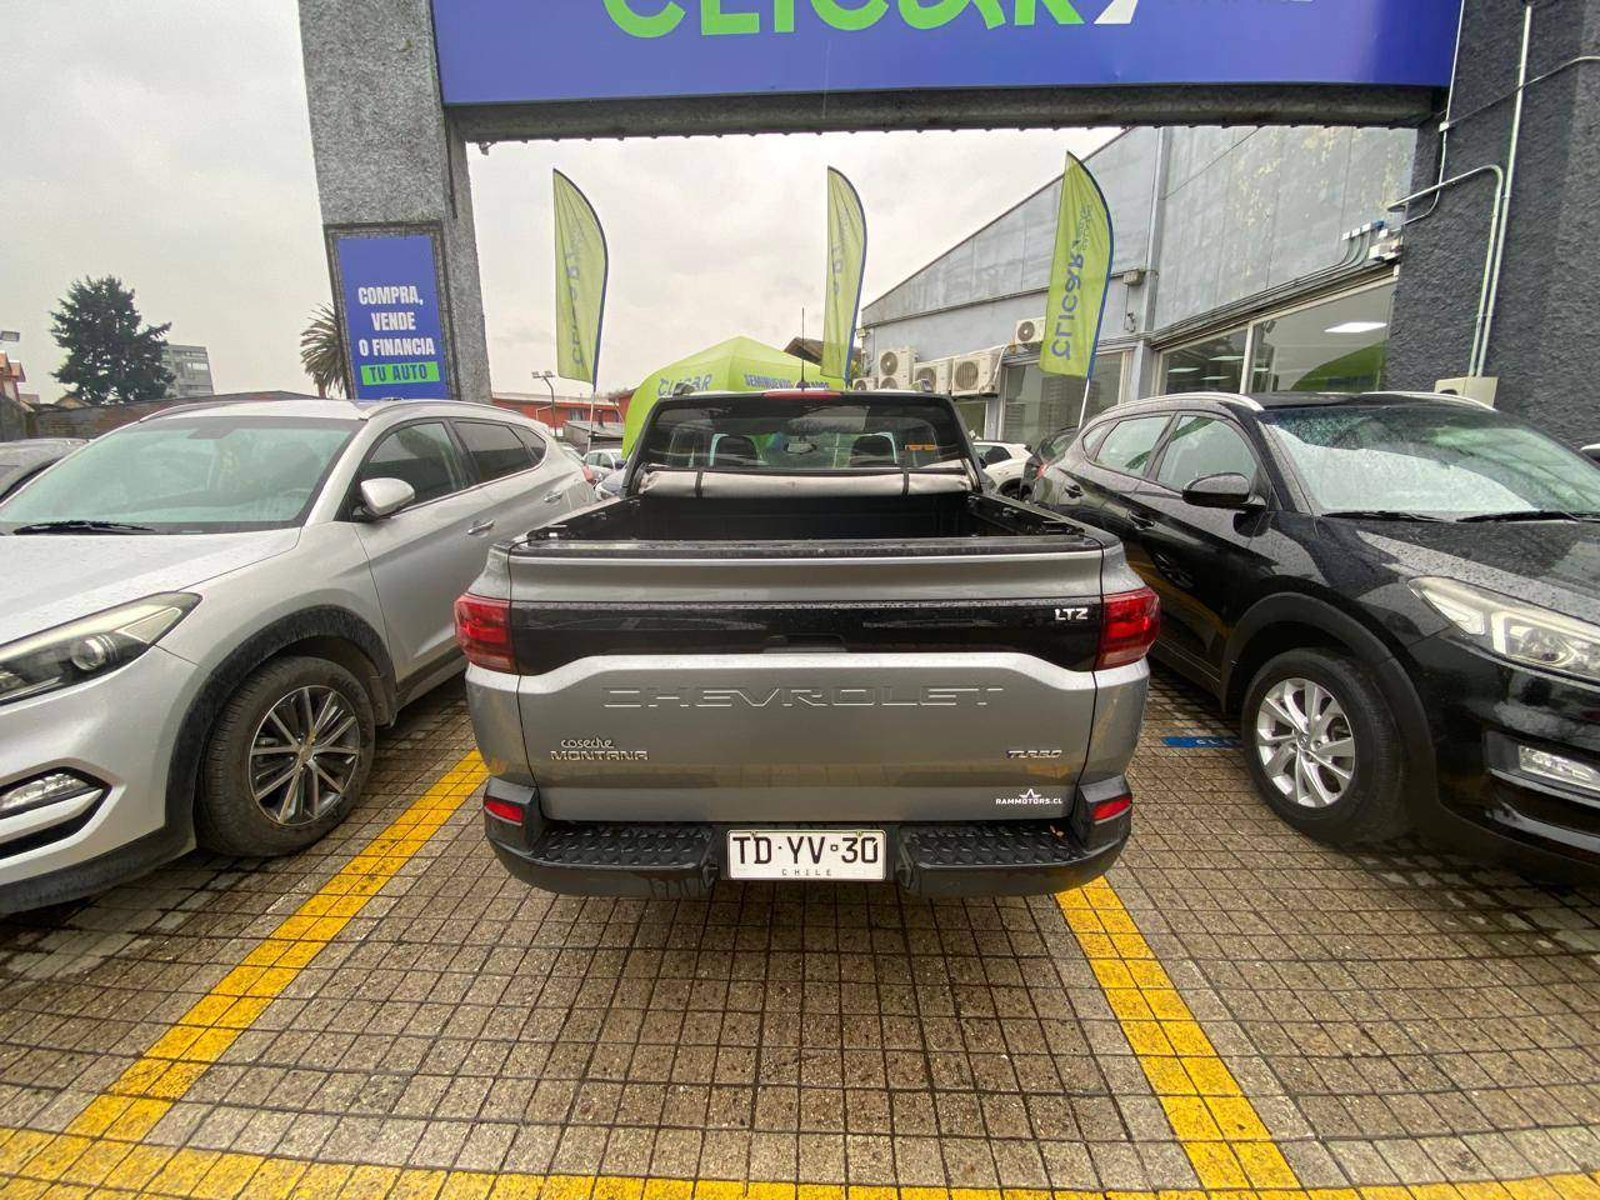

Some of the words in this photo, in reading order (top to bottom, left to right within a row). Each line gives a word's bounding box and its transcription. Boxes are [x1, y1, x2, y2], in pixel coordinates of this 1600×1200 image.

[358, 286, 423, 305] COMPRA,
[371, 312, 416, 331] VENDE
[358, 339, 369, 356] O
[372, 338, 435, 356] FINANCIA
[369, 366, 386, 382] TU
[393, 365, 428, 381] AUTO
[1055, 608, 1088, 620] LTZ
[603, 687, 1003, 707] CHEVROLET
[550, 750, 648, 761] MONTANA
